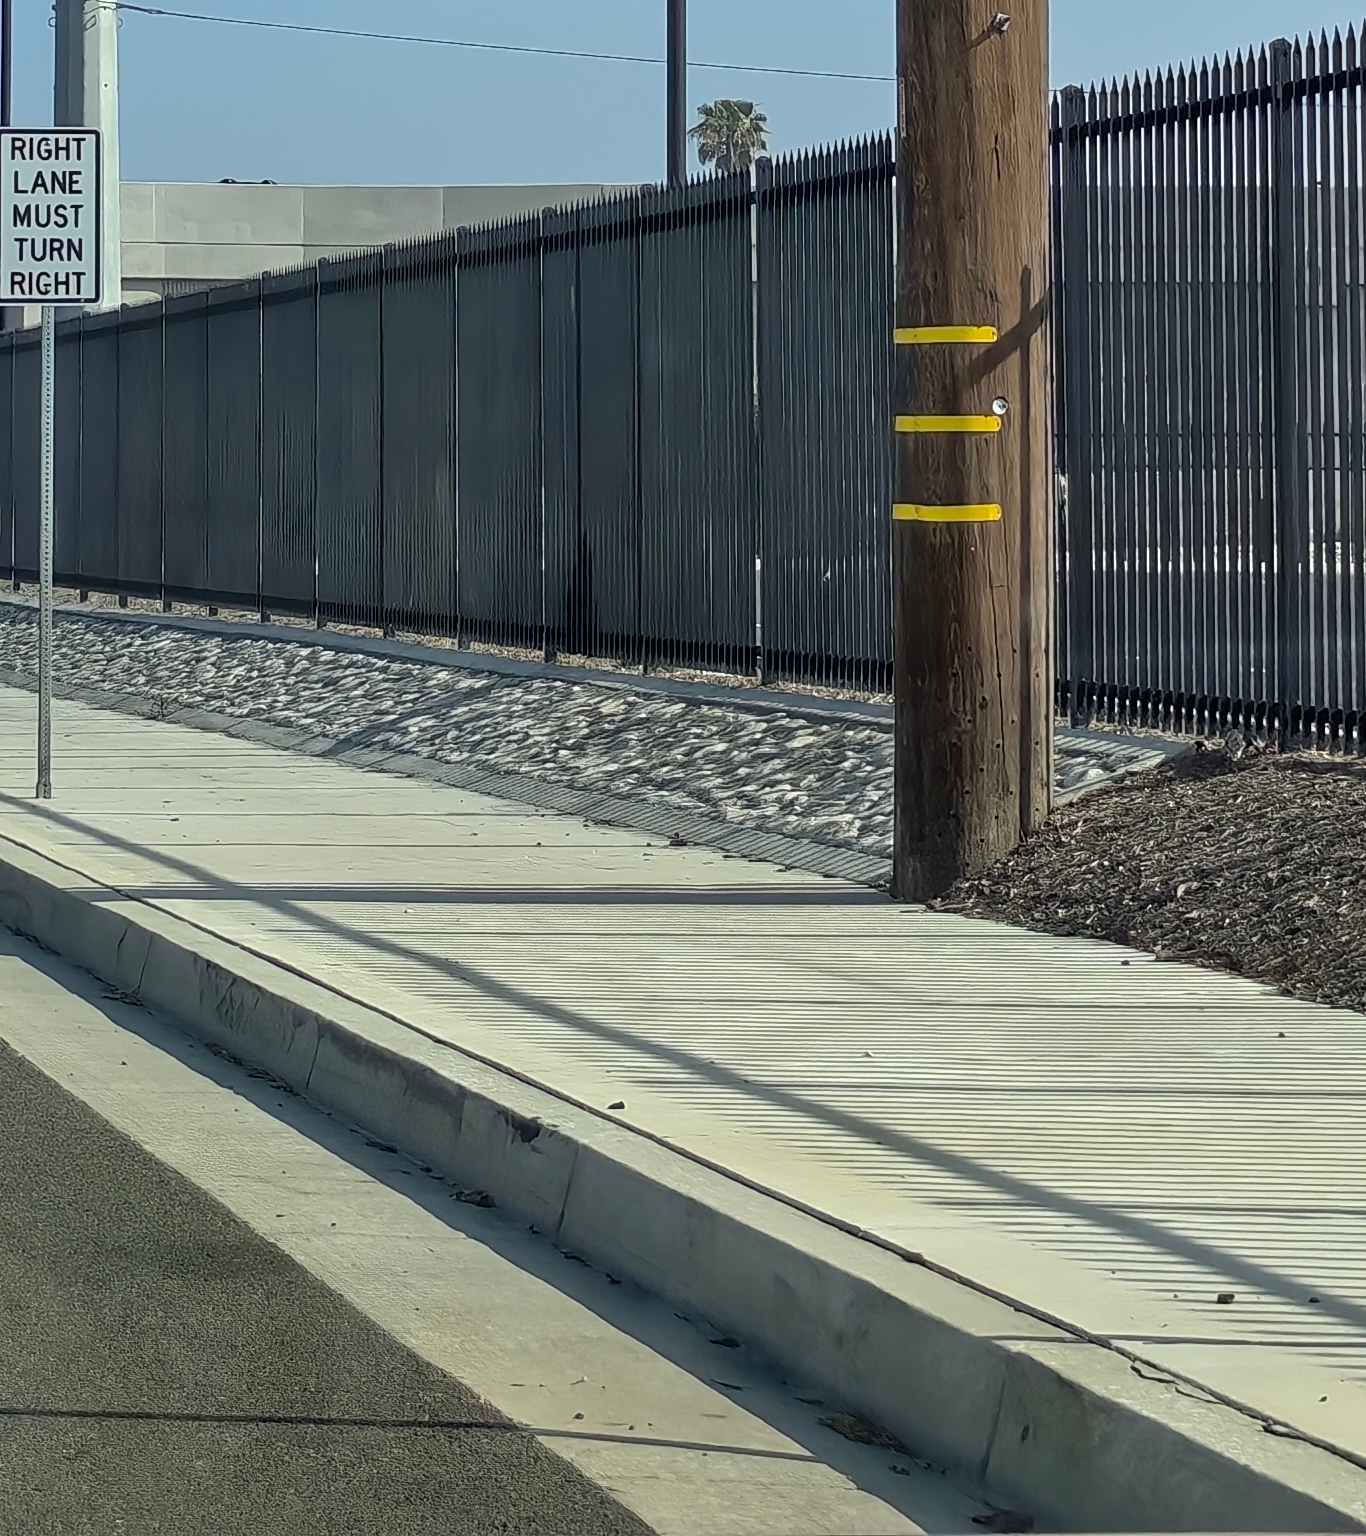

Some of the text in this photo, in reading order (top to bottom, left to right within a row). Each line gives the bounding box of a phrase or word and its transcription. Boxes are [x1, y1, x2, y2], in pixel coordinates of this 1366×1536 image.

[10, 136, 87, 161] RIGHT
[13, 170, 83, 195] LANE
[12, 203, 85, 229] MUST
[13, 237, 84, 262] TURN
[10, 271, 87, 296] RIGHT
